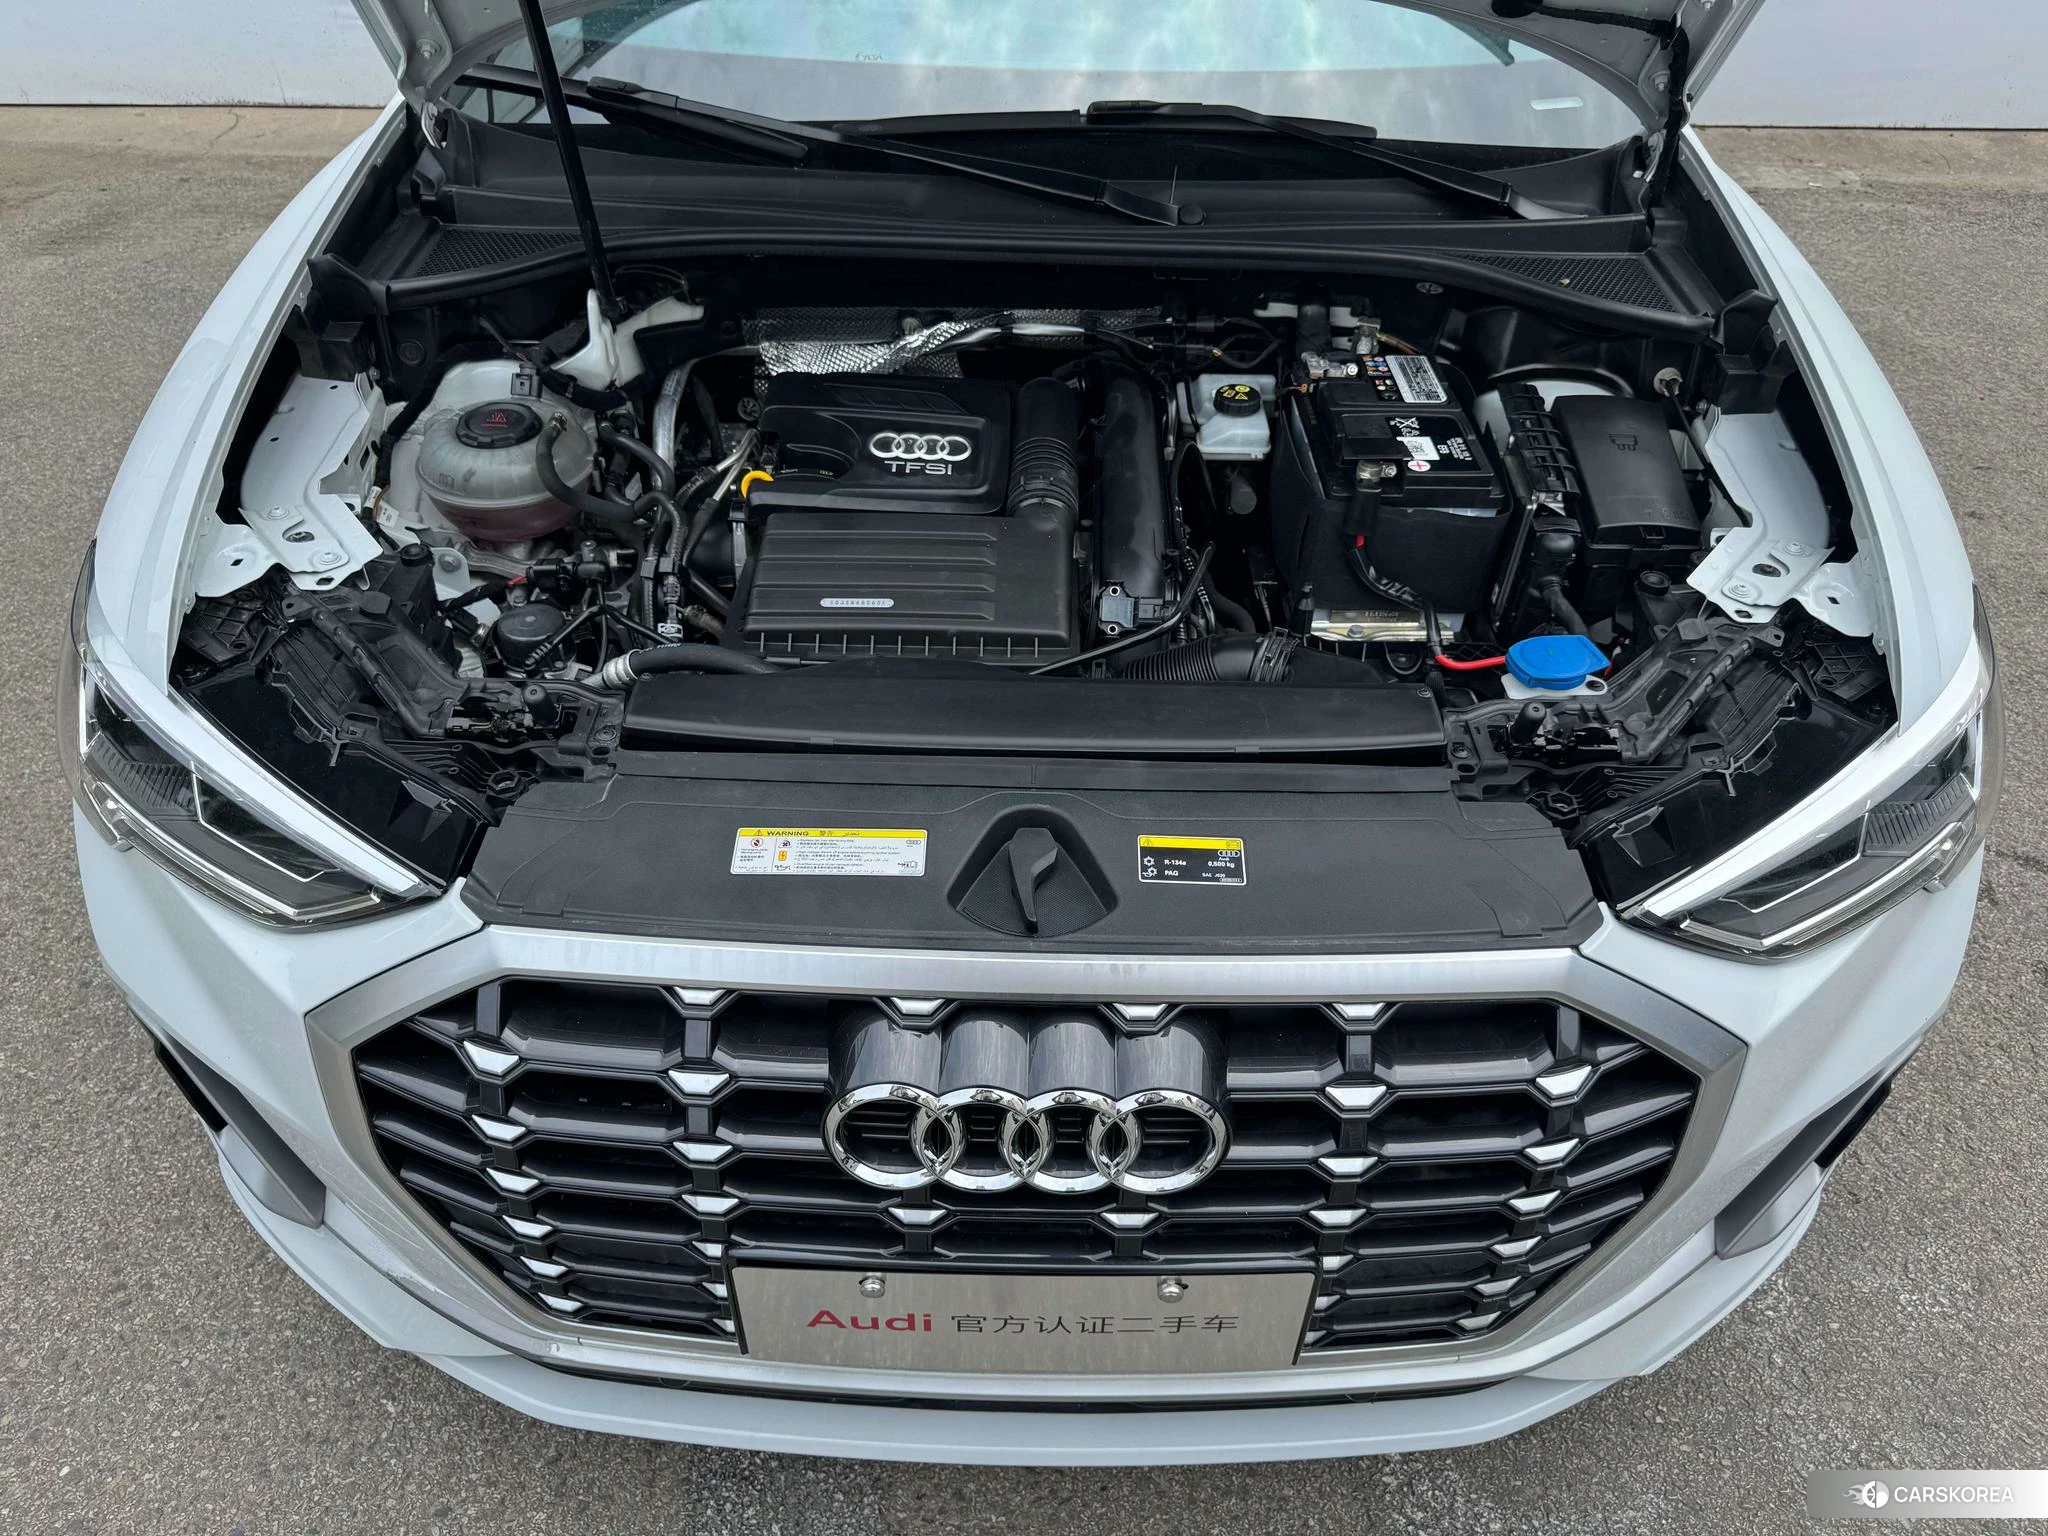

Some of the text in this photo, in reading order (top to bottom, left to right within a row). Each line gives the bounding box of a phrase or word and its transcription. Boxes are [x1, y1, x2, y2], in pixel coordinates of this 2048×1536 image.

[884, 460, 953, 475] TFSI
[807, 1309, 1240, 1335] Audi 官方认证二手车
